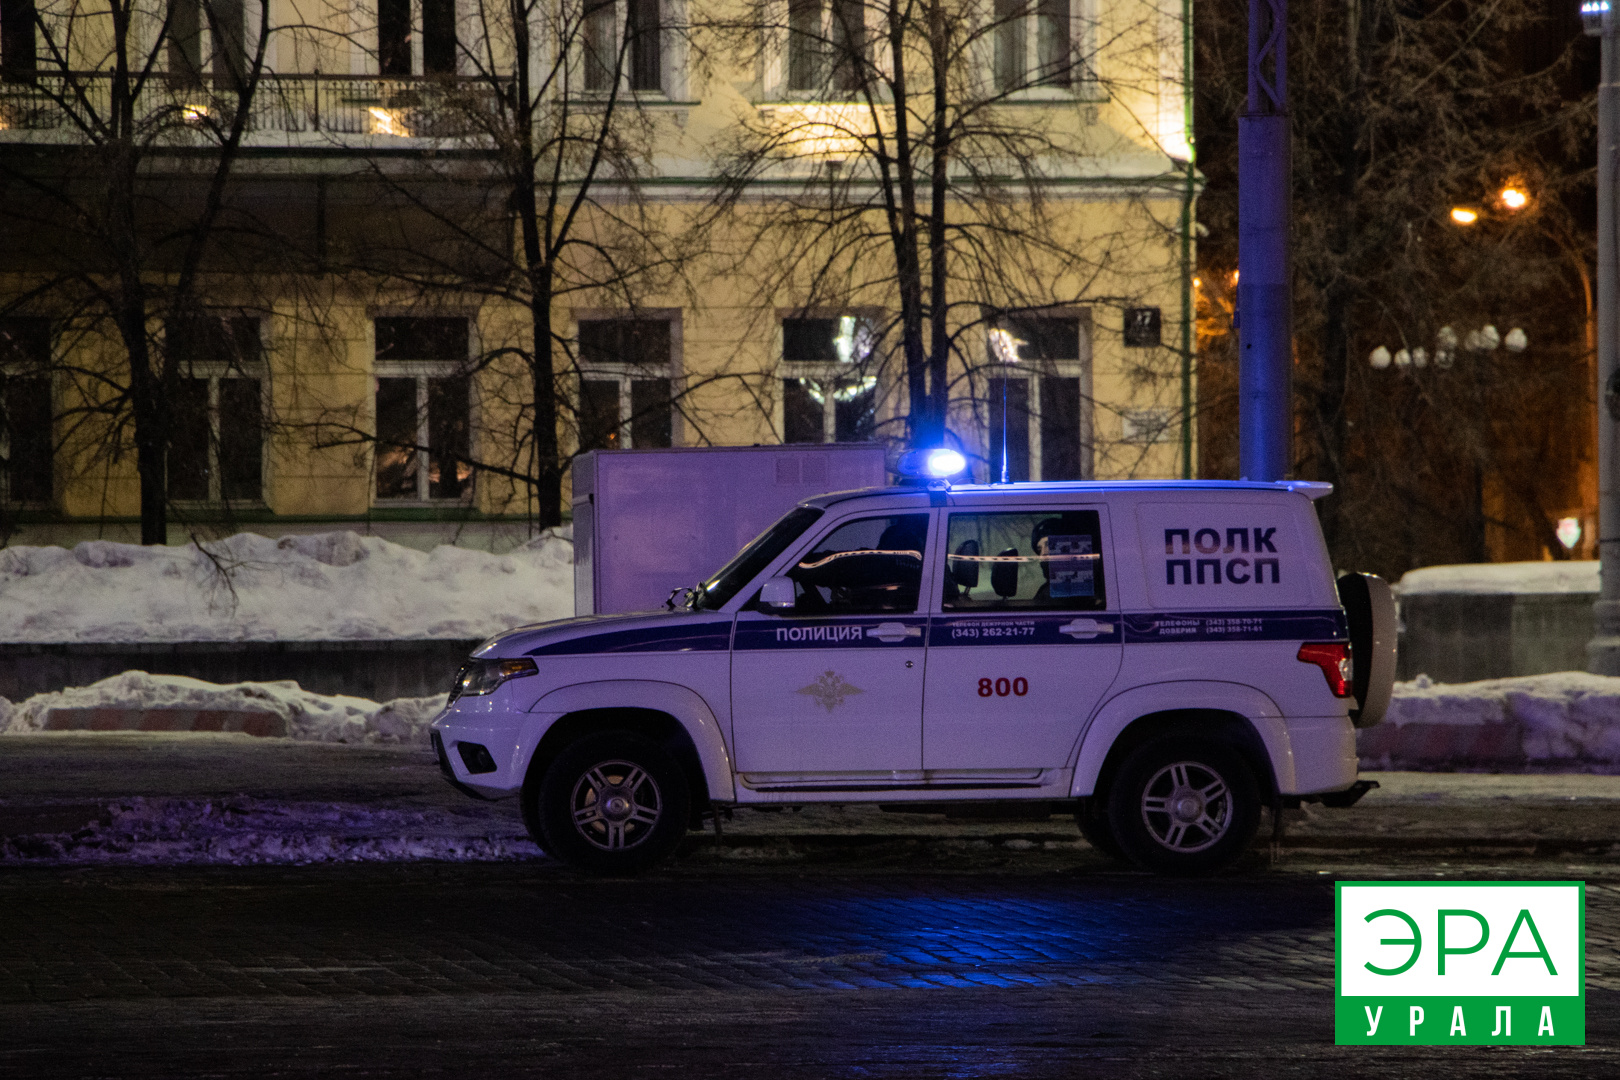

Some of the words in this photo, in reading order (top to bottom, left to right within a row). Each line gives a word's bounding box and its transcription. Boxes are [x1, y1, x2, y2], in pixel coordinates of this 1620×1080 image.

[1164, 527, 1278, 555] ПОЛК
[1166, 558, 1280, 585] ППСП
[776, 625, 863, 642] ПОЛИЦИЯ
[951, 628, 979, 639] (343)
[982, 627, 1035, 636] 262-21-77
[1159, 627, 1197, 635] ДОВЕРИЯ
[1206, 626, 1225, 634] (343)
[977, 676, 1029, 698] 800
